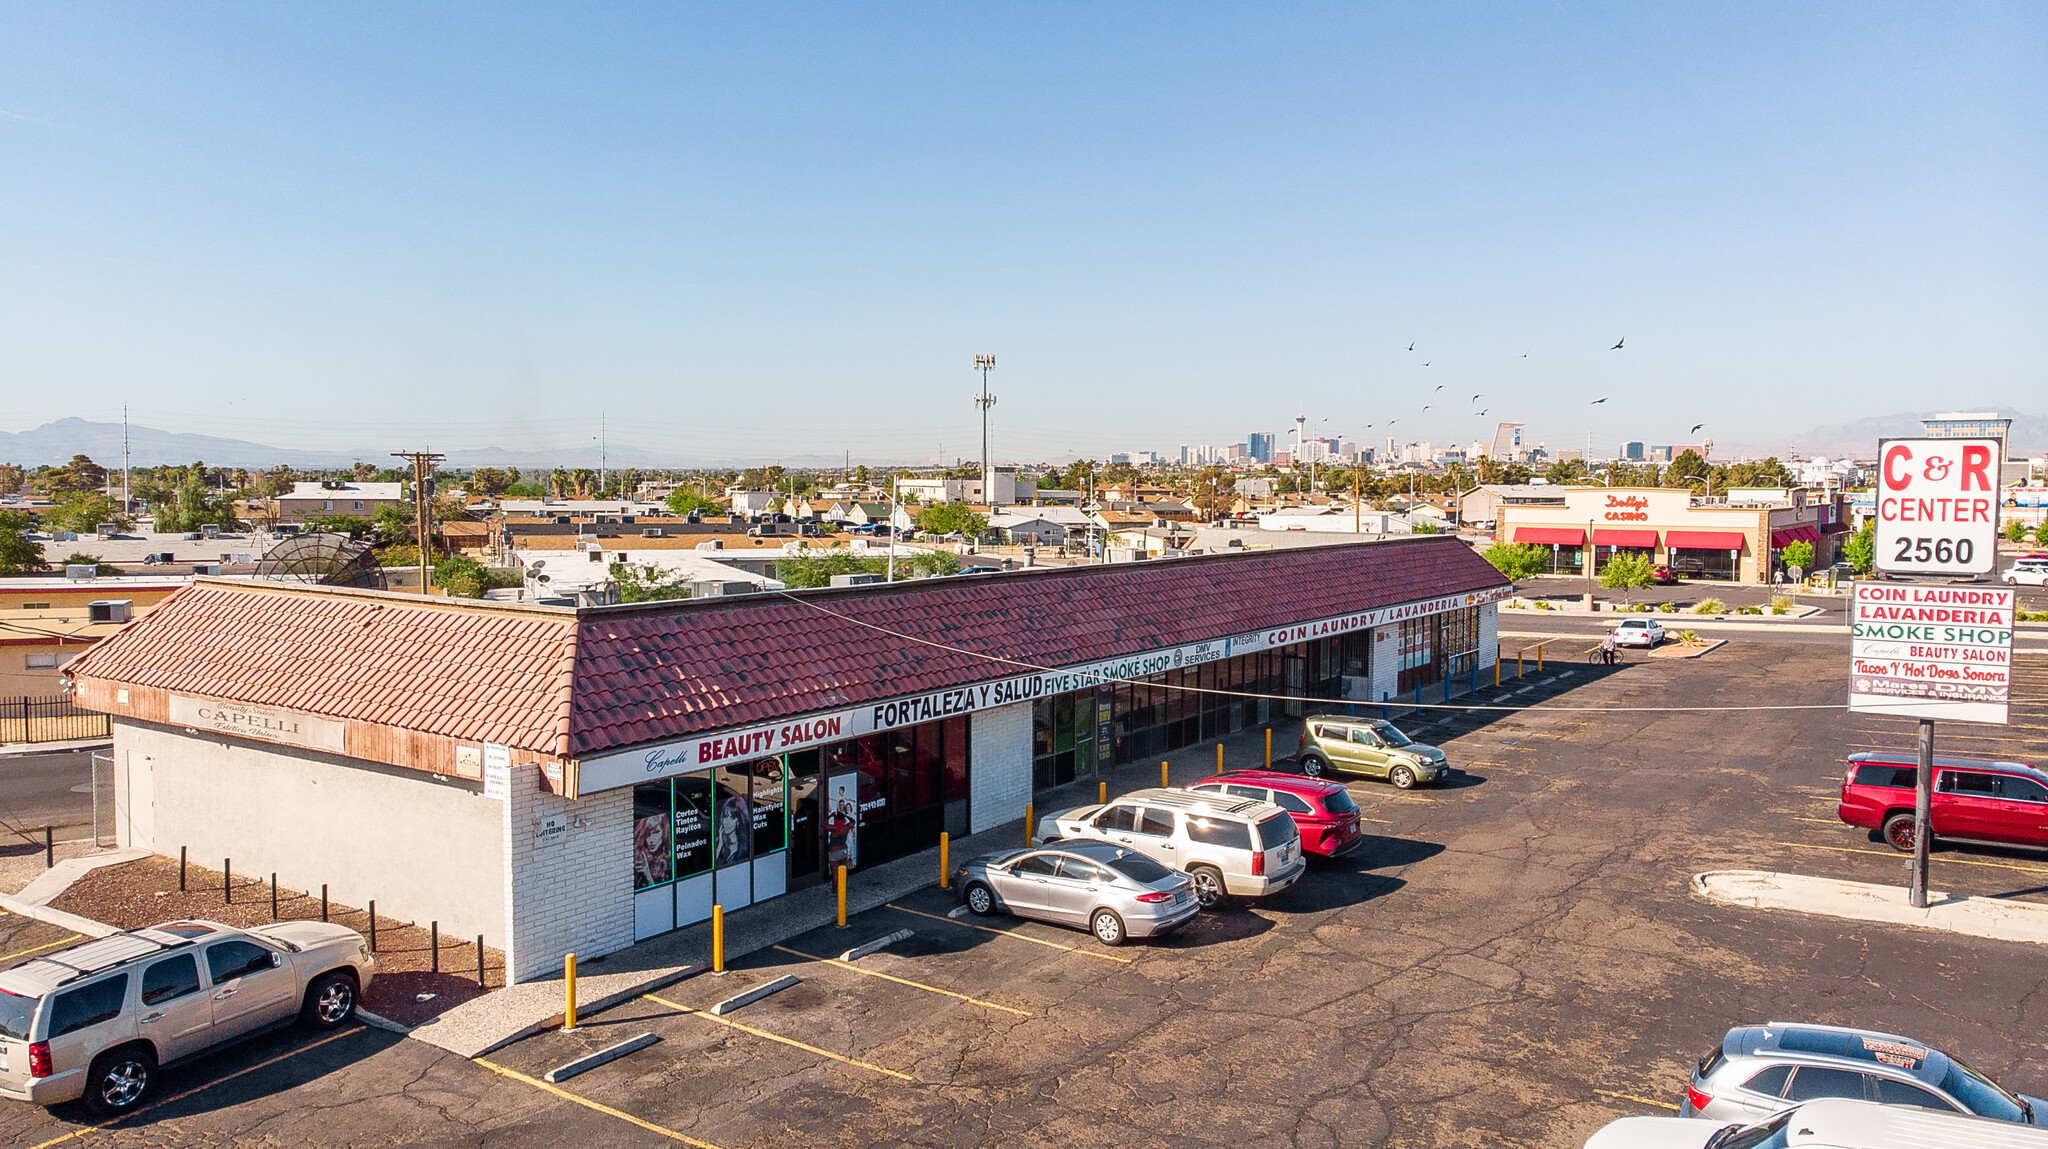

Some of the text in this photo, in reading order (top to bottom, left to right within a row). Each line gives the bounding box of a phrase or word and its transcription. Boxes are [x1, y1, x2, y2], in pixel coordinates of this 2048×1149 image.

[1883, 445, 1992, 491] C & R
[1604, 511, 1648, 521] CASINO
[1881, 498, 1990, 522] CENTER
[1894, 537, 1974, 564] 2560
[1858, 587, 2008, 606] COIN LAUNDRY
[1268, 625, 1306, 645] COIN
[1313, 613, 1376, 635] LAUNDRY
[1389, 598, 1458, 620] LAVANDERIA
[1860, 605, 2004, 625] LAVANDERIA
[1232, 633, 1260, 646] INTEGRITY
[1853, 623, 2012, 644] SMOKE SHOP
[1196, 643, 1211, 654] DMV
[1910, 646, 1958, 659] BEAUTY
[1962, 648, 2006, 663] SALON
[1185, 651, 1220, 664] SERVICES
[1045, 677, 1070, 694] FIVE
[1073, 669, 1100, 689] STAR
[1102, 660, 1140, 682] SMOKE
[1143, 655, 1170, 674] SHOP
[1854, 660, 2006, 682] Tacos Y Hot Dogs Sonora
[1872, 688, 1926, 696] SERVICES
[1935, 683, 2008, 695] DMV
[873, 675, 1042, 730] FORTALEZA Y SALUD
[217, 702, 277, 717] Beauty Salon
[198, 708, 300, 734] CAPELLI
[644, 717, 841, 773] Capelli BEAUTY SALON
[756, 761, 779, 773] OPEN
[753, 786, 783, 798] Highlights
[675, 808, 699, 819] Cortes
[753, 802, 783, 814] Hairstyles
[546, 820, 555, 828] NO
[675, 816, 698, 826] Tintes
[753, 814, 767, 822] Wax
[675, 823, 701, 835] Rayitos
[753, 821, 768, 830] Cuts
[676, 838, 707, 852] Peinados
[676, 850, 692, 860] Wax
